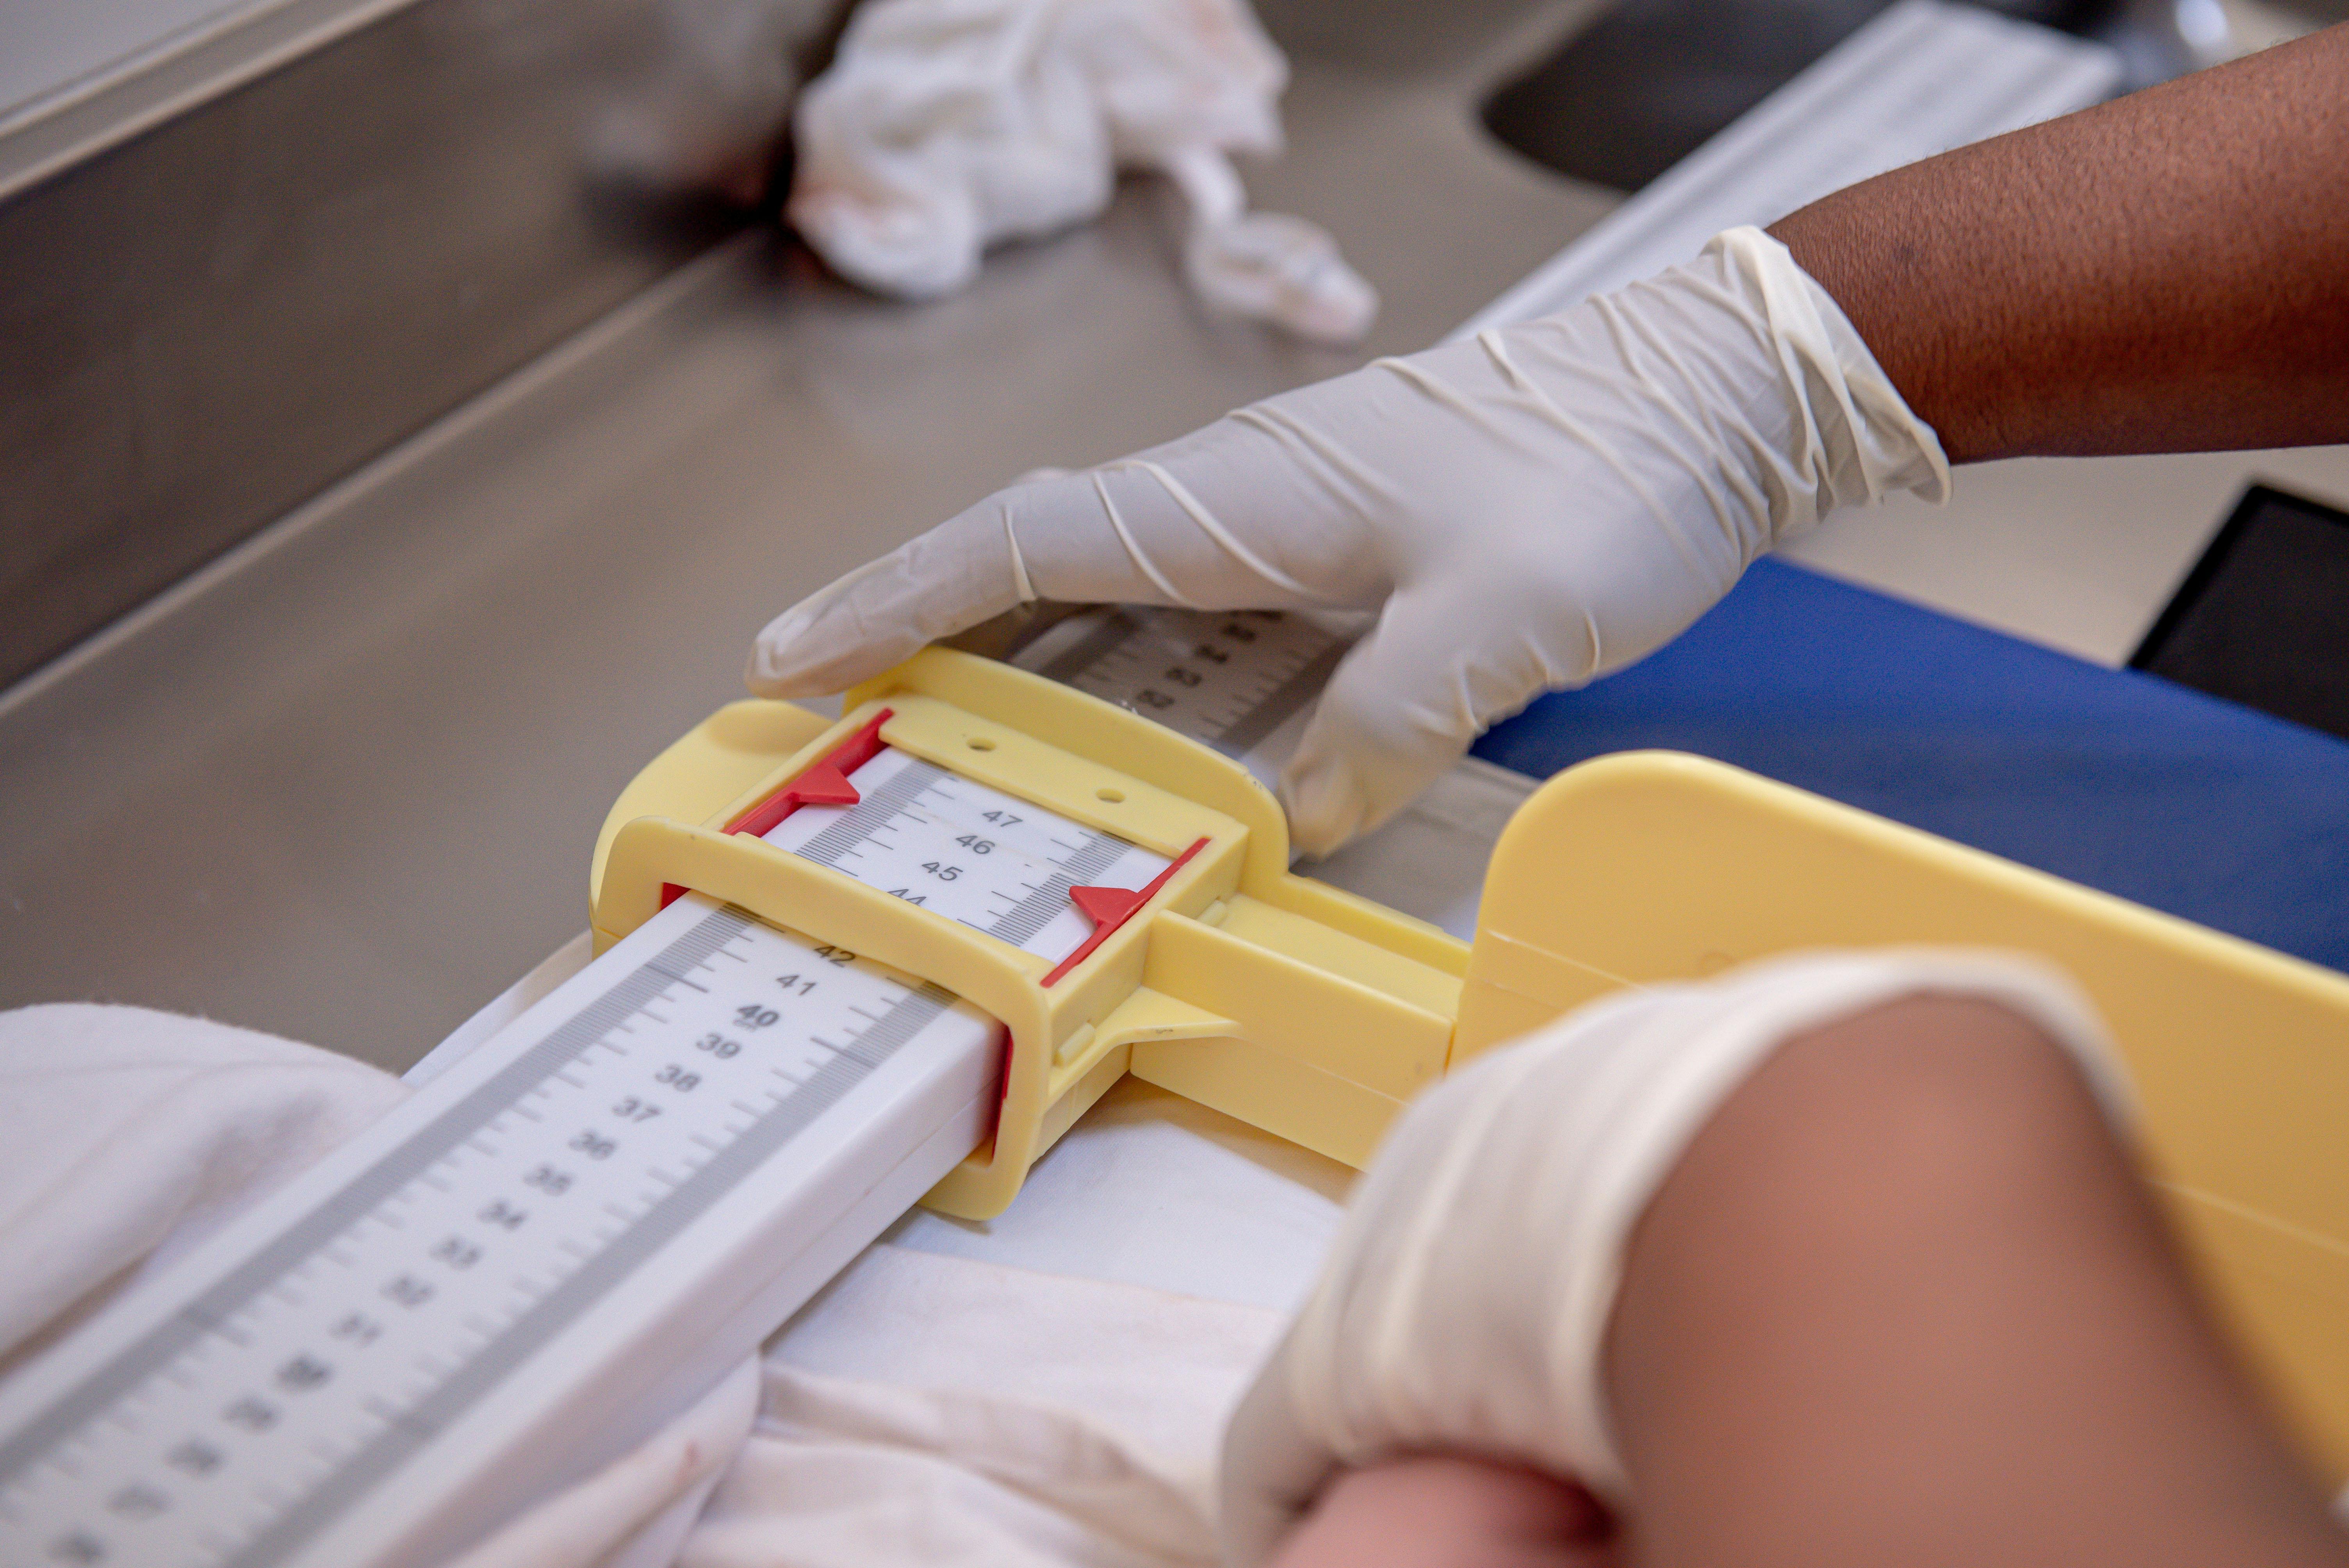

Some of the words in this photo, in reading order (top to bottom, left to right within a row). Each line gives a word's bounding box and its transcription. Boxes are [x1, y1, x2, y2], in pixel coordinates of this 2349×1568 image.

[982, 811, 1023, 827] 47
[955, 835, 996, 855] 46
[921, 862, 963, 881] 45
[814, 944, 856, 967] 42
[776, 974, 816, 996] 41
[736, 1005, 780, 1027] 40
[696, 1033, 741, 1059] 39
[655, 1065, 702, 1092] 38
[613, 1098, 661, 1122] 37
[569, 1131, 617, 1160] 36
